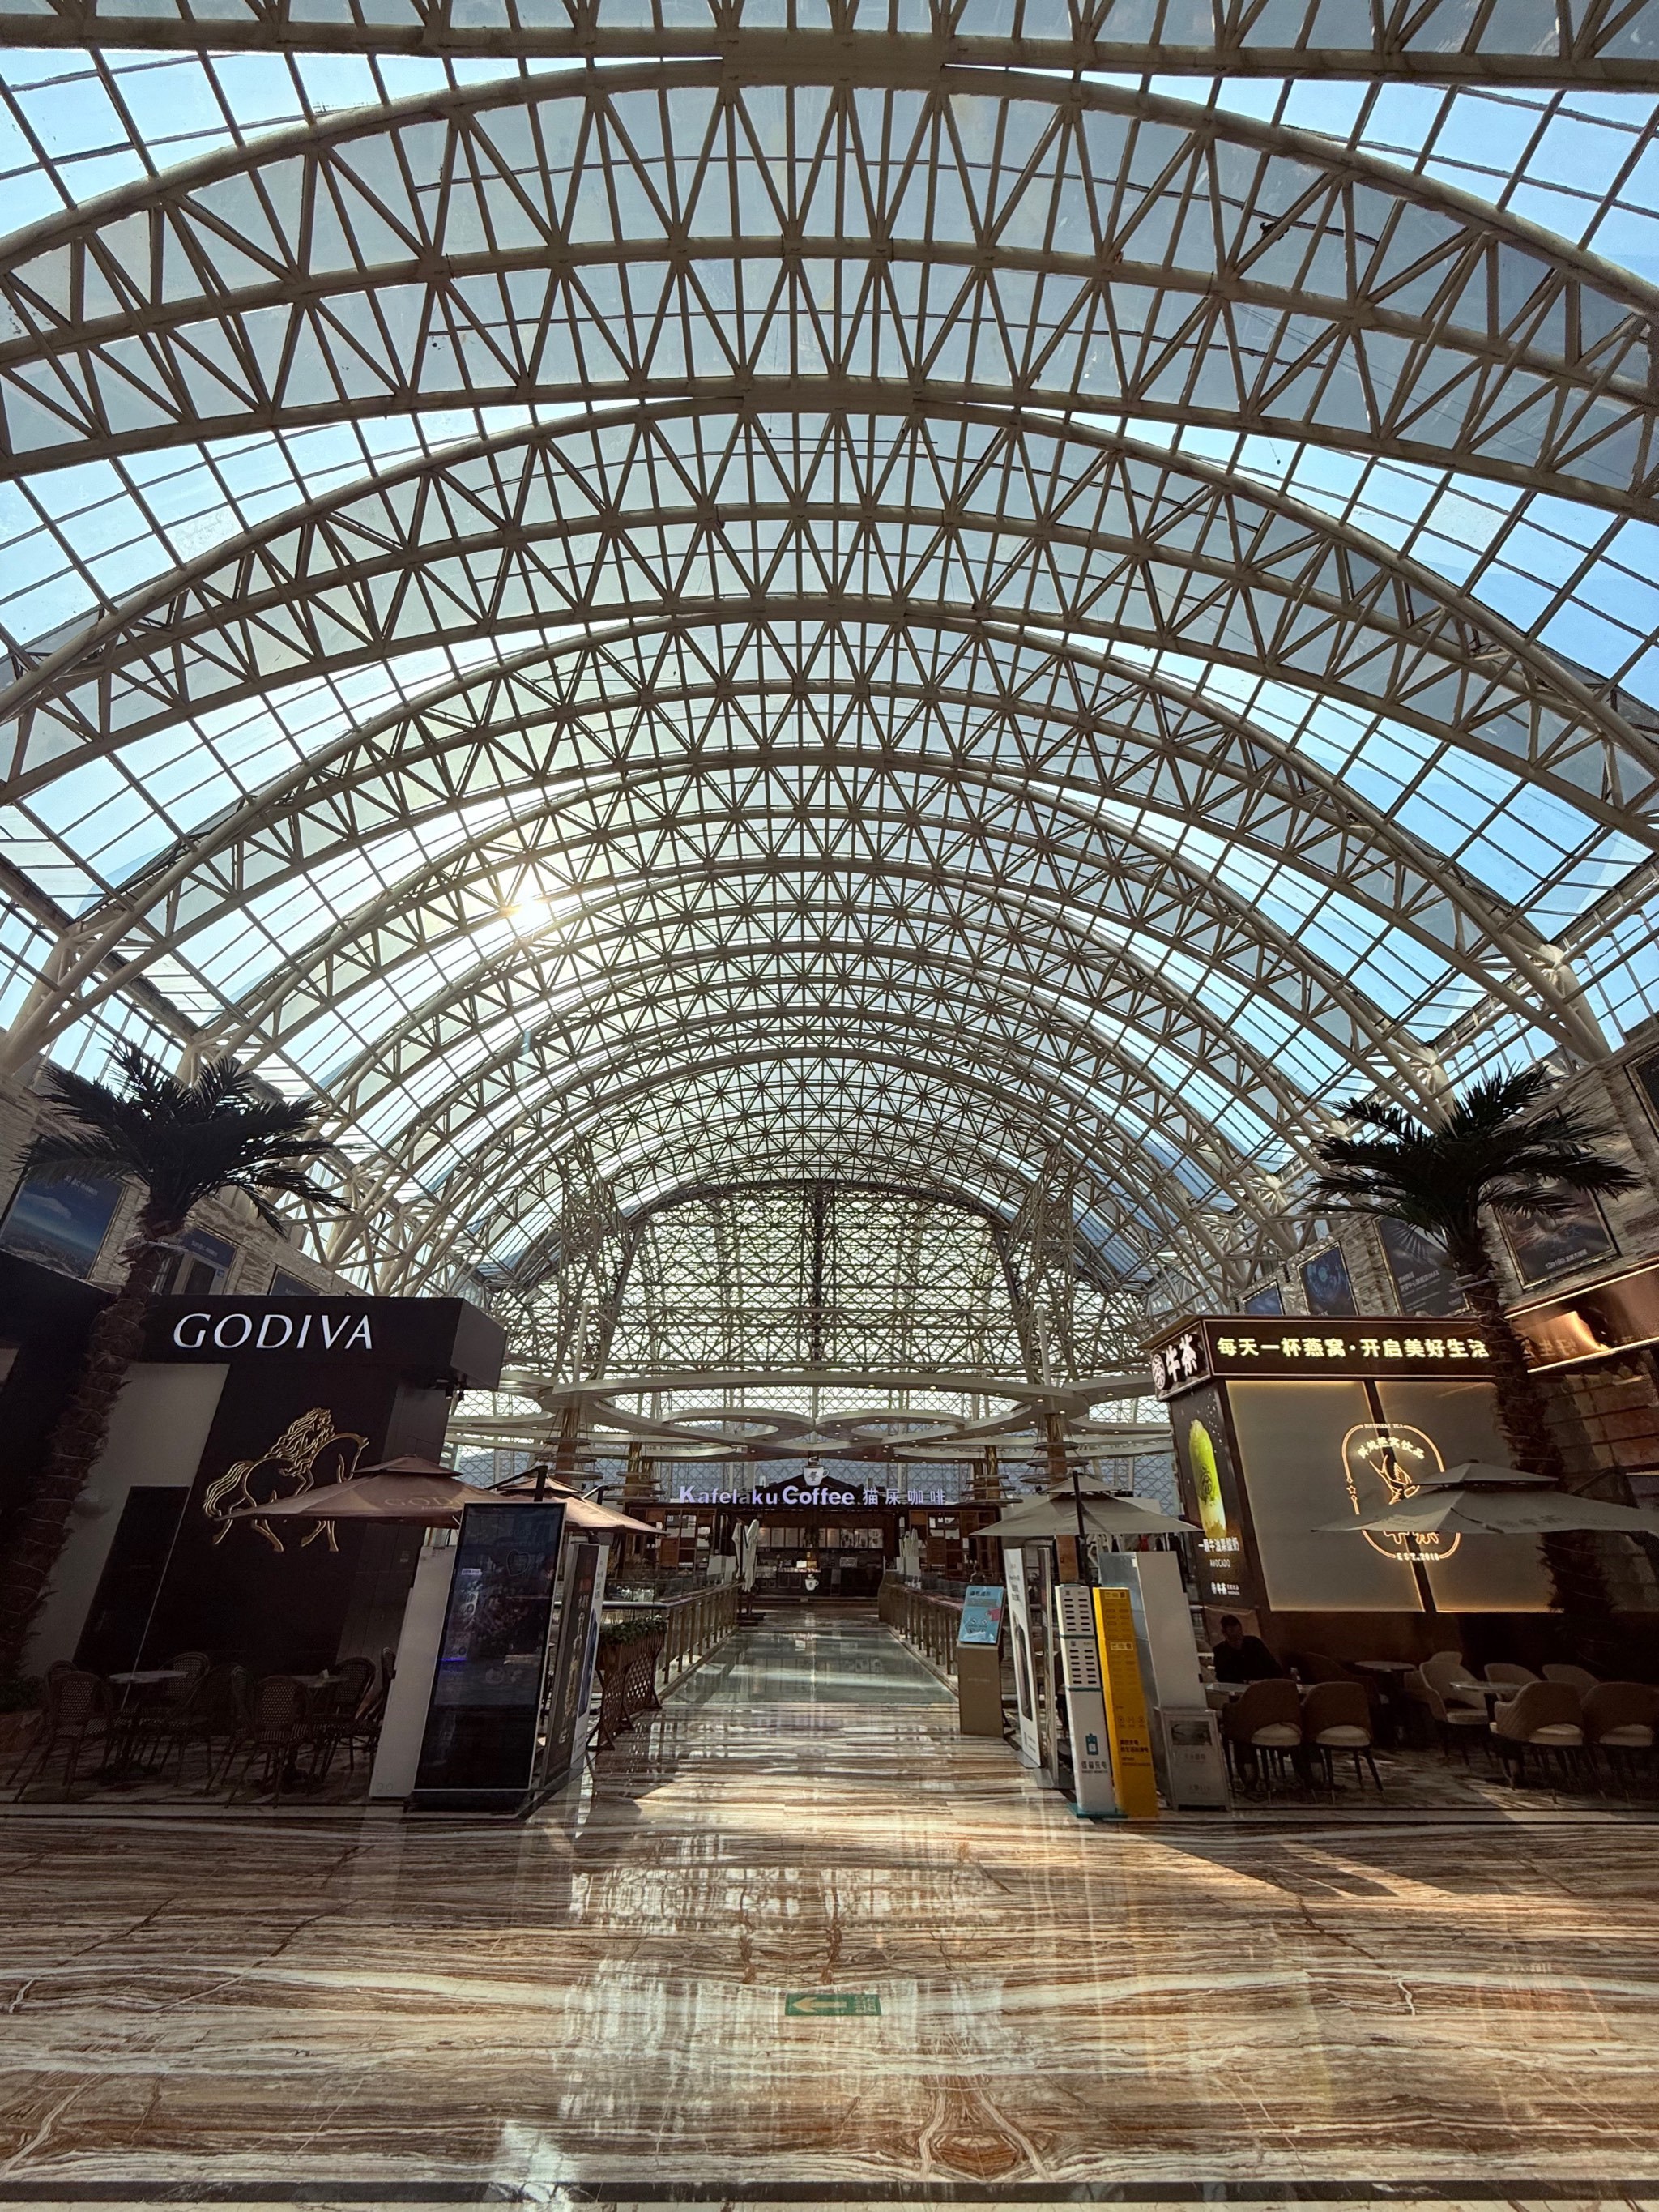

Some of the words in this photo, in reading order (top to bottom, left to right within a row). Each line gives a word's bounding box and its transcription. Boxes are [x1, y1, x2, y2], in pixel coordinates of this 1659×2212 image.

[173, 1313, 374, 1351] GODIVA
[1216, 1336, 1491, 1359] 每天一杯燕窝·开启美好生活
[679, 1485, 778, 1505] Kafelaku
[781, 1485, 855, 1505] Coffee
[862, 1488, 946, 1506] 猫屎咖啡
[1209, 1558, 1231, 1568] AVOCADO
